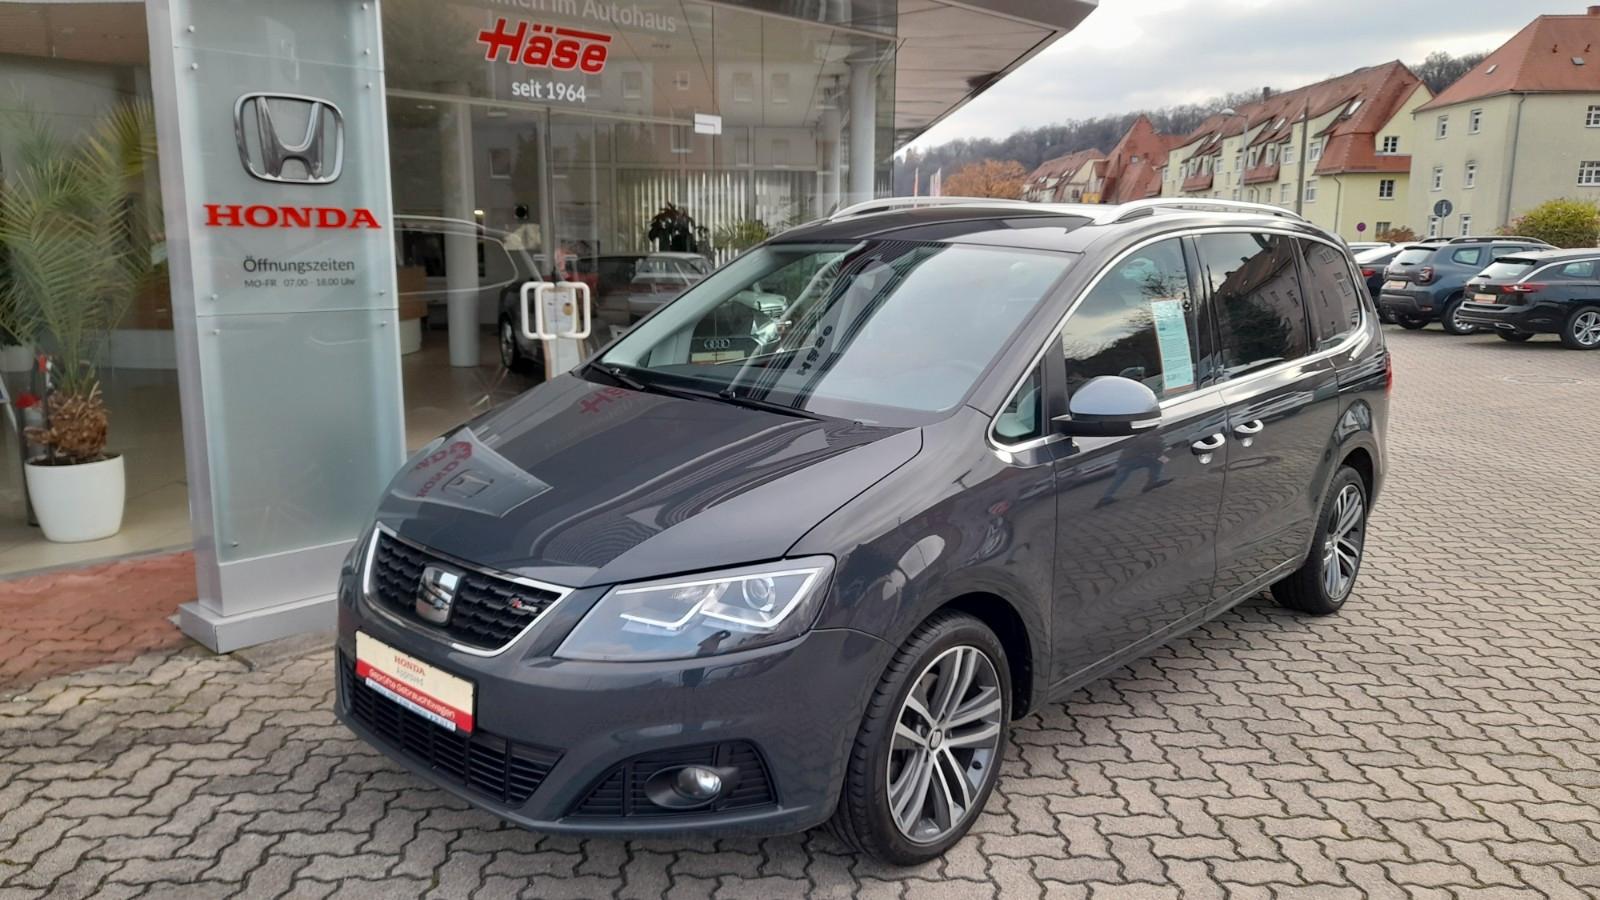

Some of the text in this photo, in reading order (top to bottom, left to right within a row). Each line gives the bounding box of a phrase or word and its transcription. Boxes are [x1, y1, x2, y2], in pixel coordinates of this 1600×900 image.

[582, 1, 677, 32] Autohaus
[477, 17, 612, 75] Häse
[511, 79, 587, 103] seit 1964
[203, 204, 382, 229] HONDA
[243, 255, 356, 274] Öffnungszeiten
[394, 655, 426, 677] HONDA
